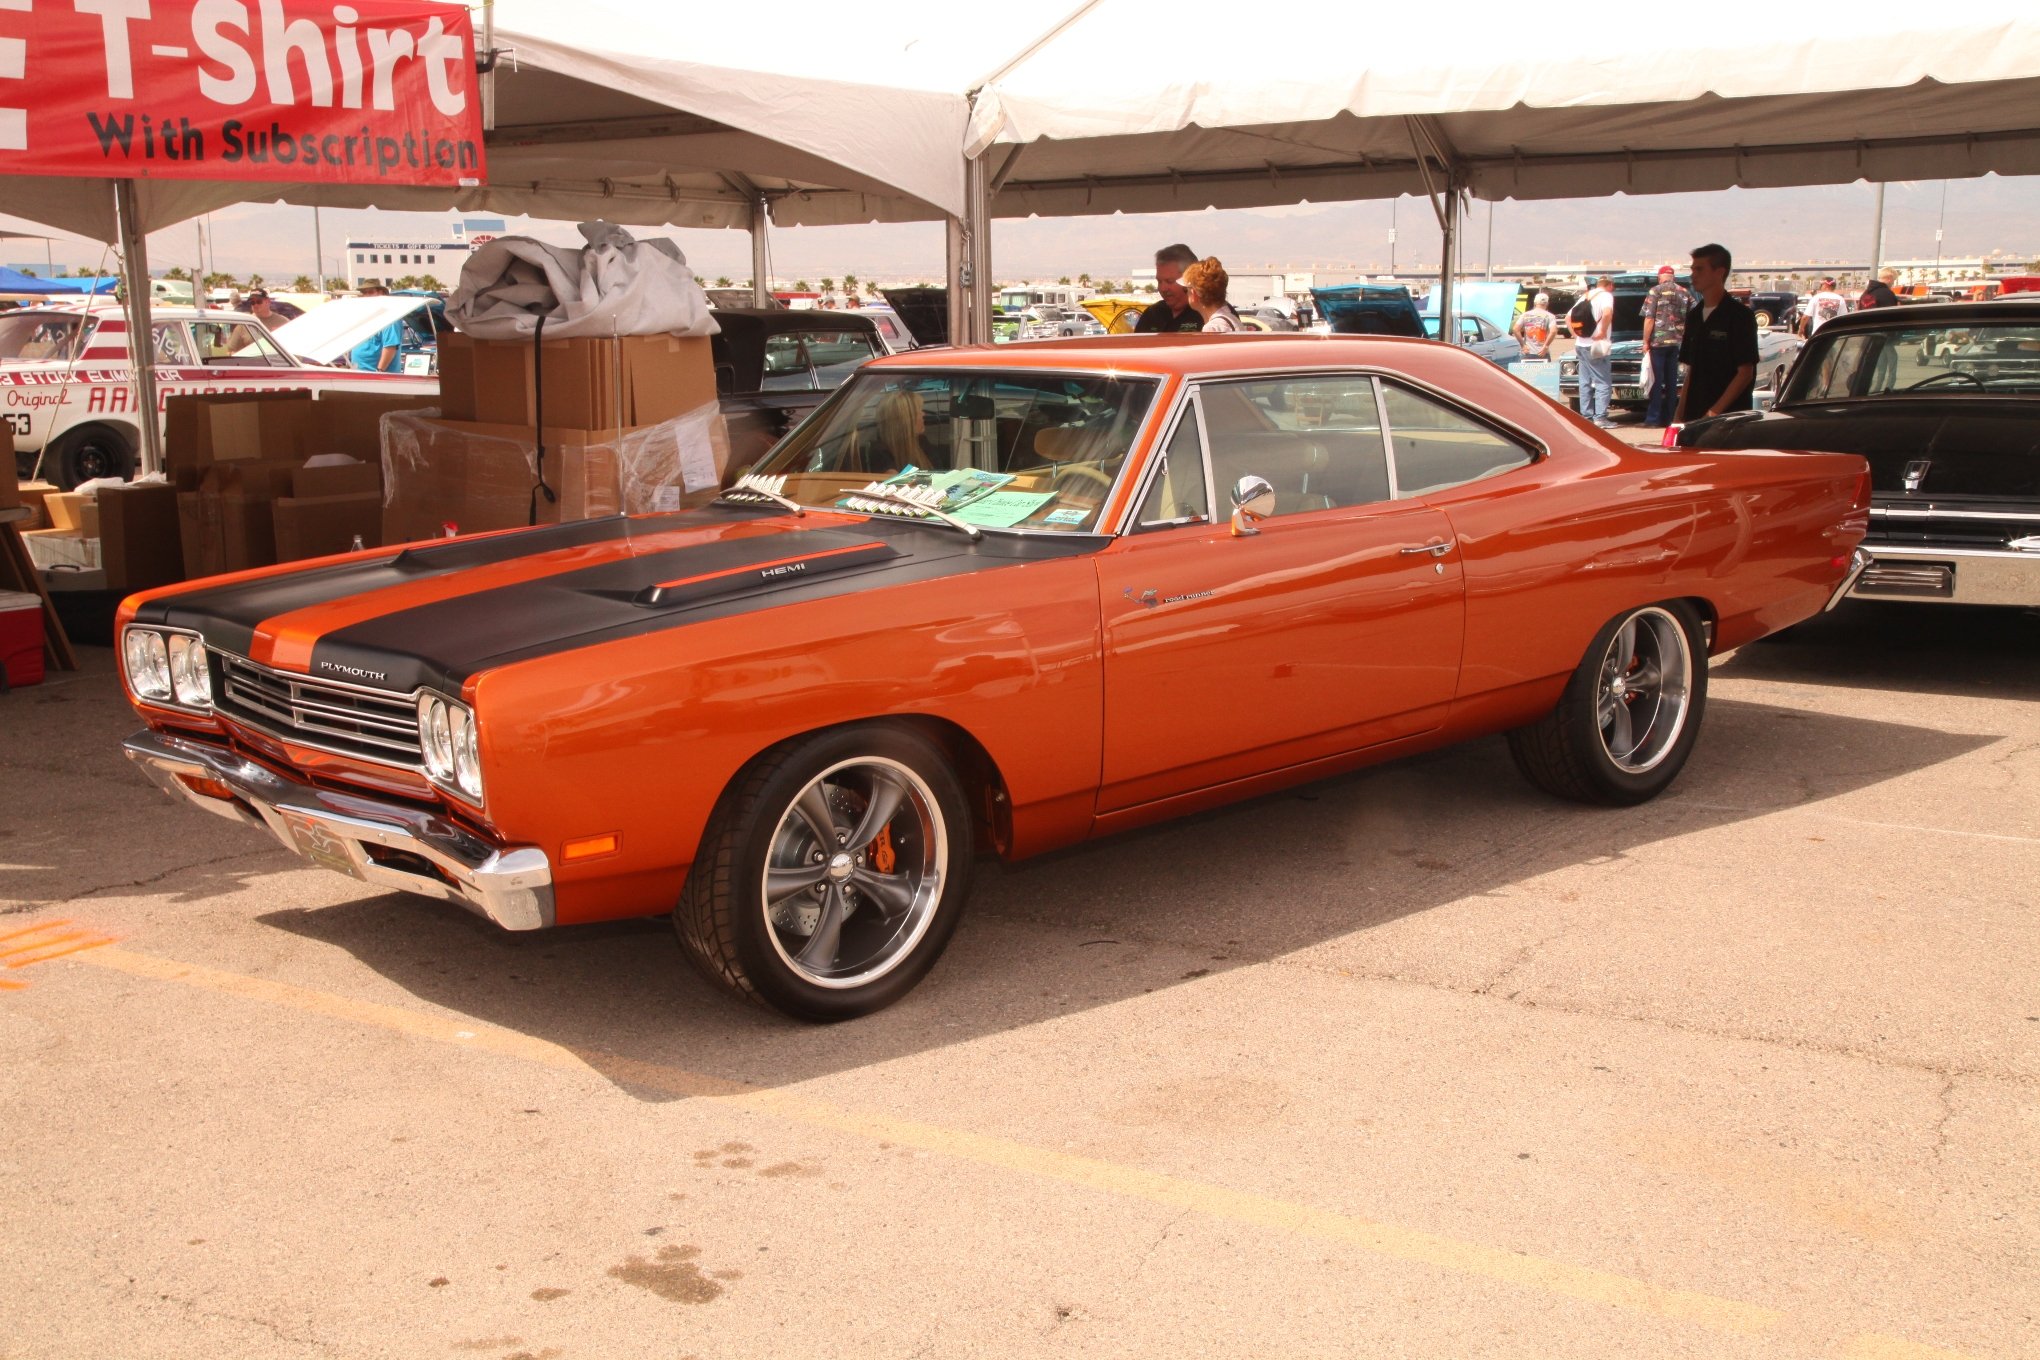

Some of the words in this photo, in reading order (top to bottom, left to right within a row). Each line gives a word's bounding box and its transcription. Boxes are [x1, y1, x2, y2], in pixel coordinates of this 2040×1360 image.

[74, 0, 466, 116] T-Shirt
[87, 112, 204, 161] With
[221, 119, 478, 176] Subscription
[761, 563, 806, 577] HEMI
[320, 661, 385, 681] PLYMOUTH
